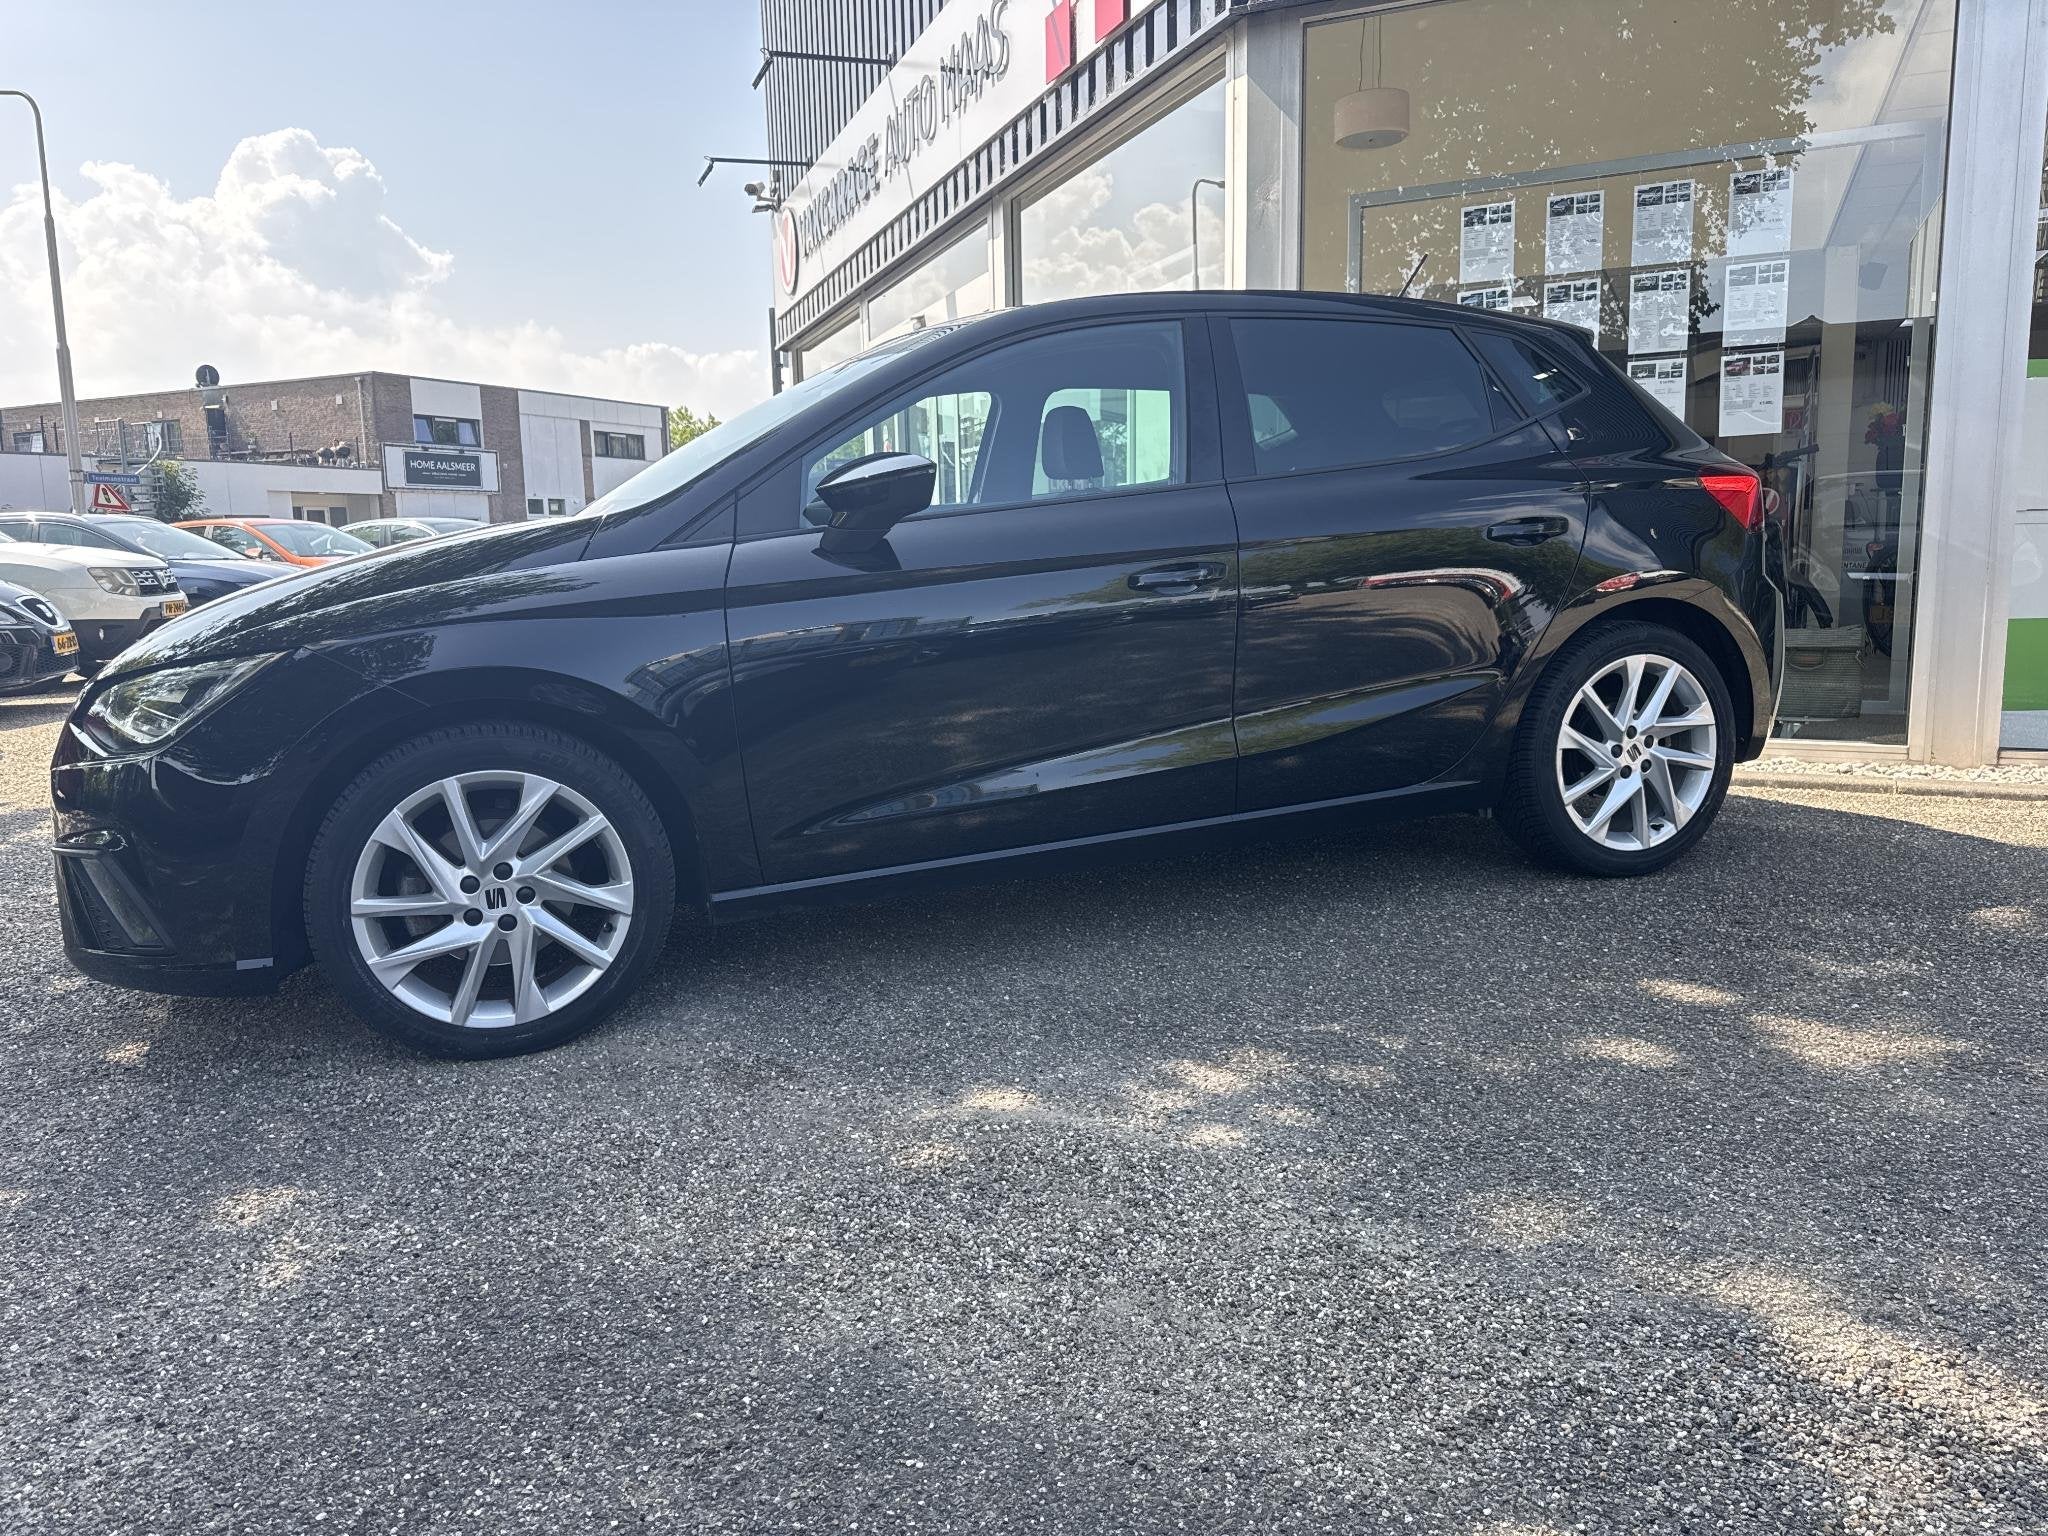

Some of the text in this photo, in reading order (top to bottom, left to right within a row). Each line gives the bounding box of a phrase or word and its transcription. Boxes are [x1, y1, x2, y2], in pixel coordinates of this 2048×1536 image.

[800, 0, 1009, 257] VAKGARAGE AUTO MAAS
[410, 460, 476, 472] HOME AALSMEER
